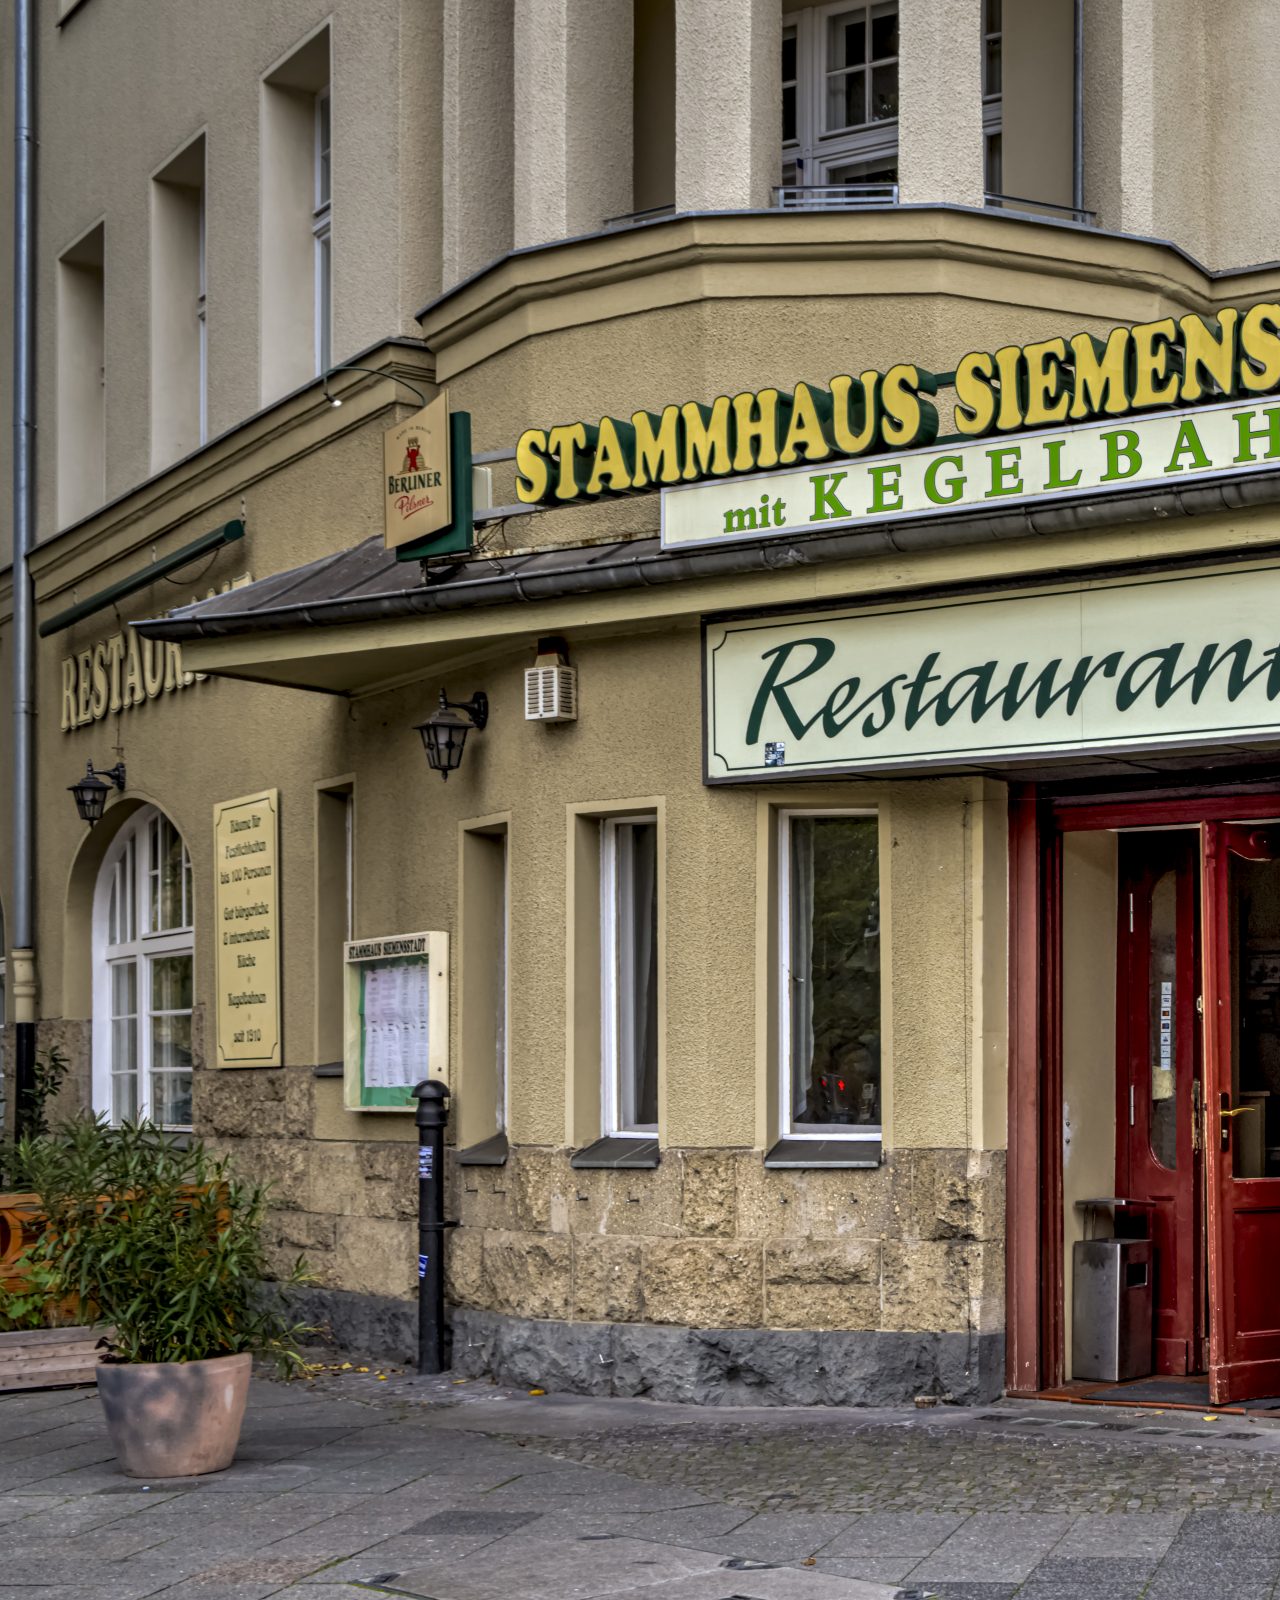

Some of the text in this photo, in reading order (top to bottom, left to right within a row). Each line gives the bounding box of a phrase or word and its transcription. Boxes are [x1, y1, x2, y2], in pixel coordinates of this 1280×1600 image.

[515, 363, 927, 503] STAMMHAUS
[388, 471, 442, 495] BERLINER
[394, 494, 434, 517] Pilsner
[723, 494, 787, 534] mit
[349, 937, 426, 959] STAMMHAUS SIEMENSSTADT
